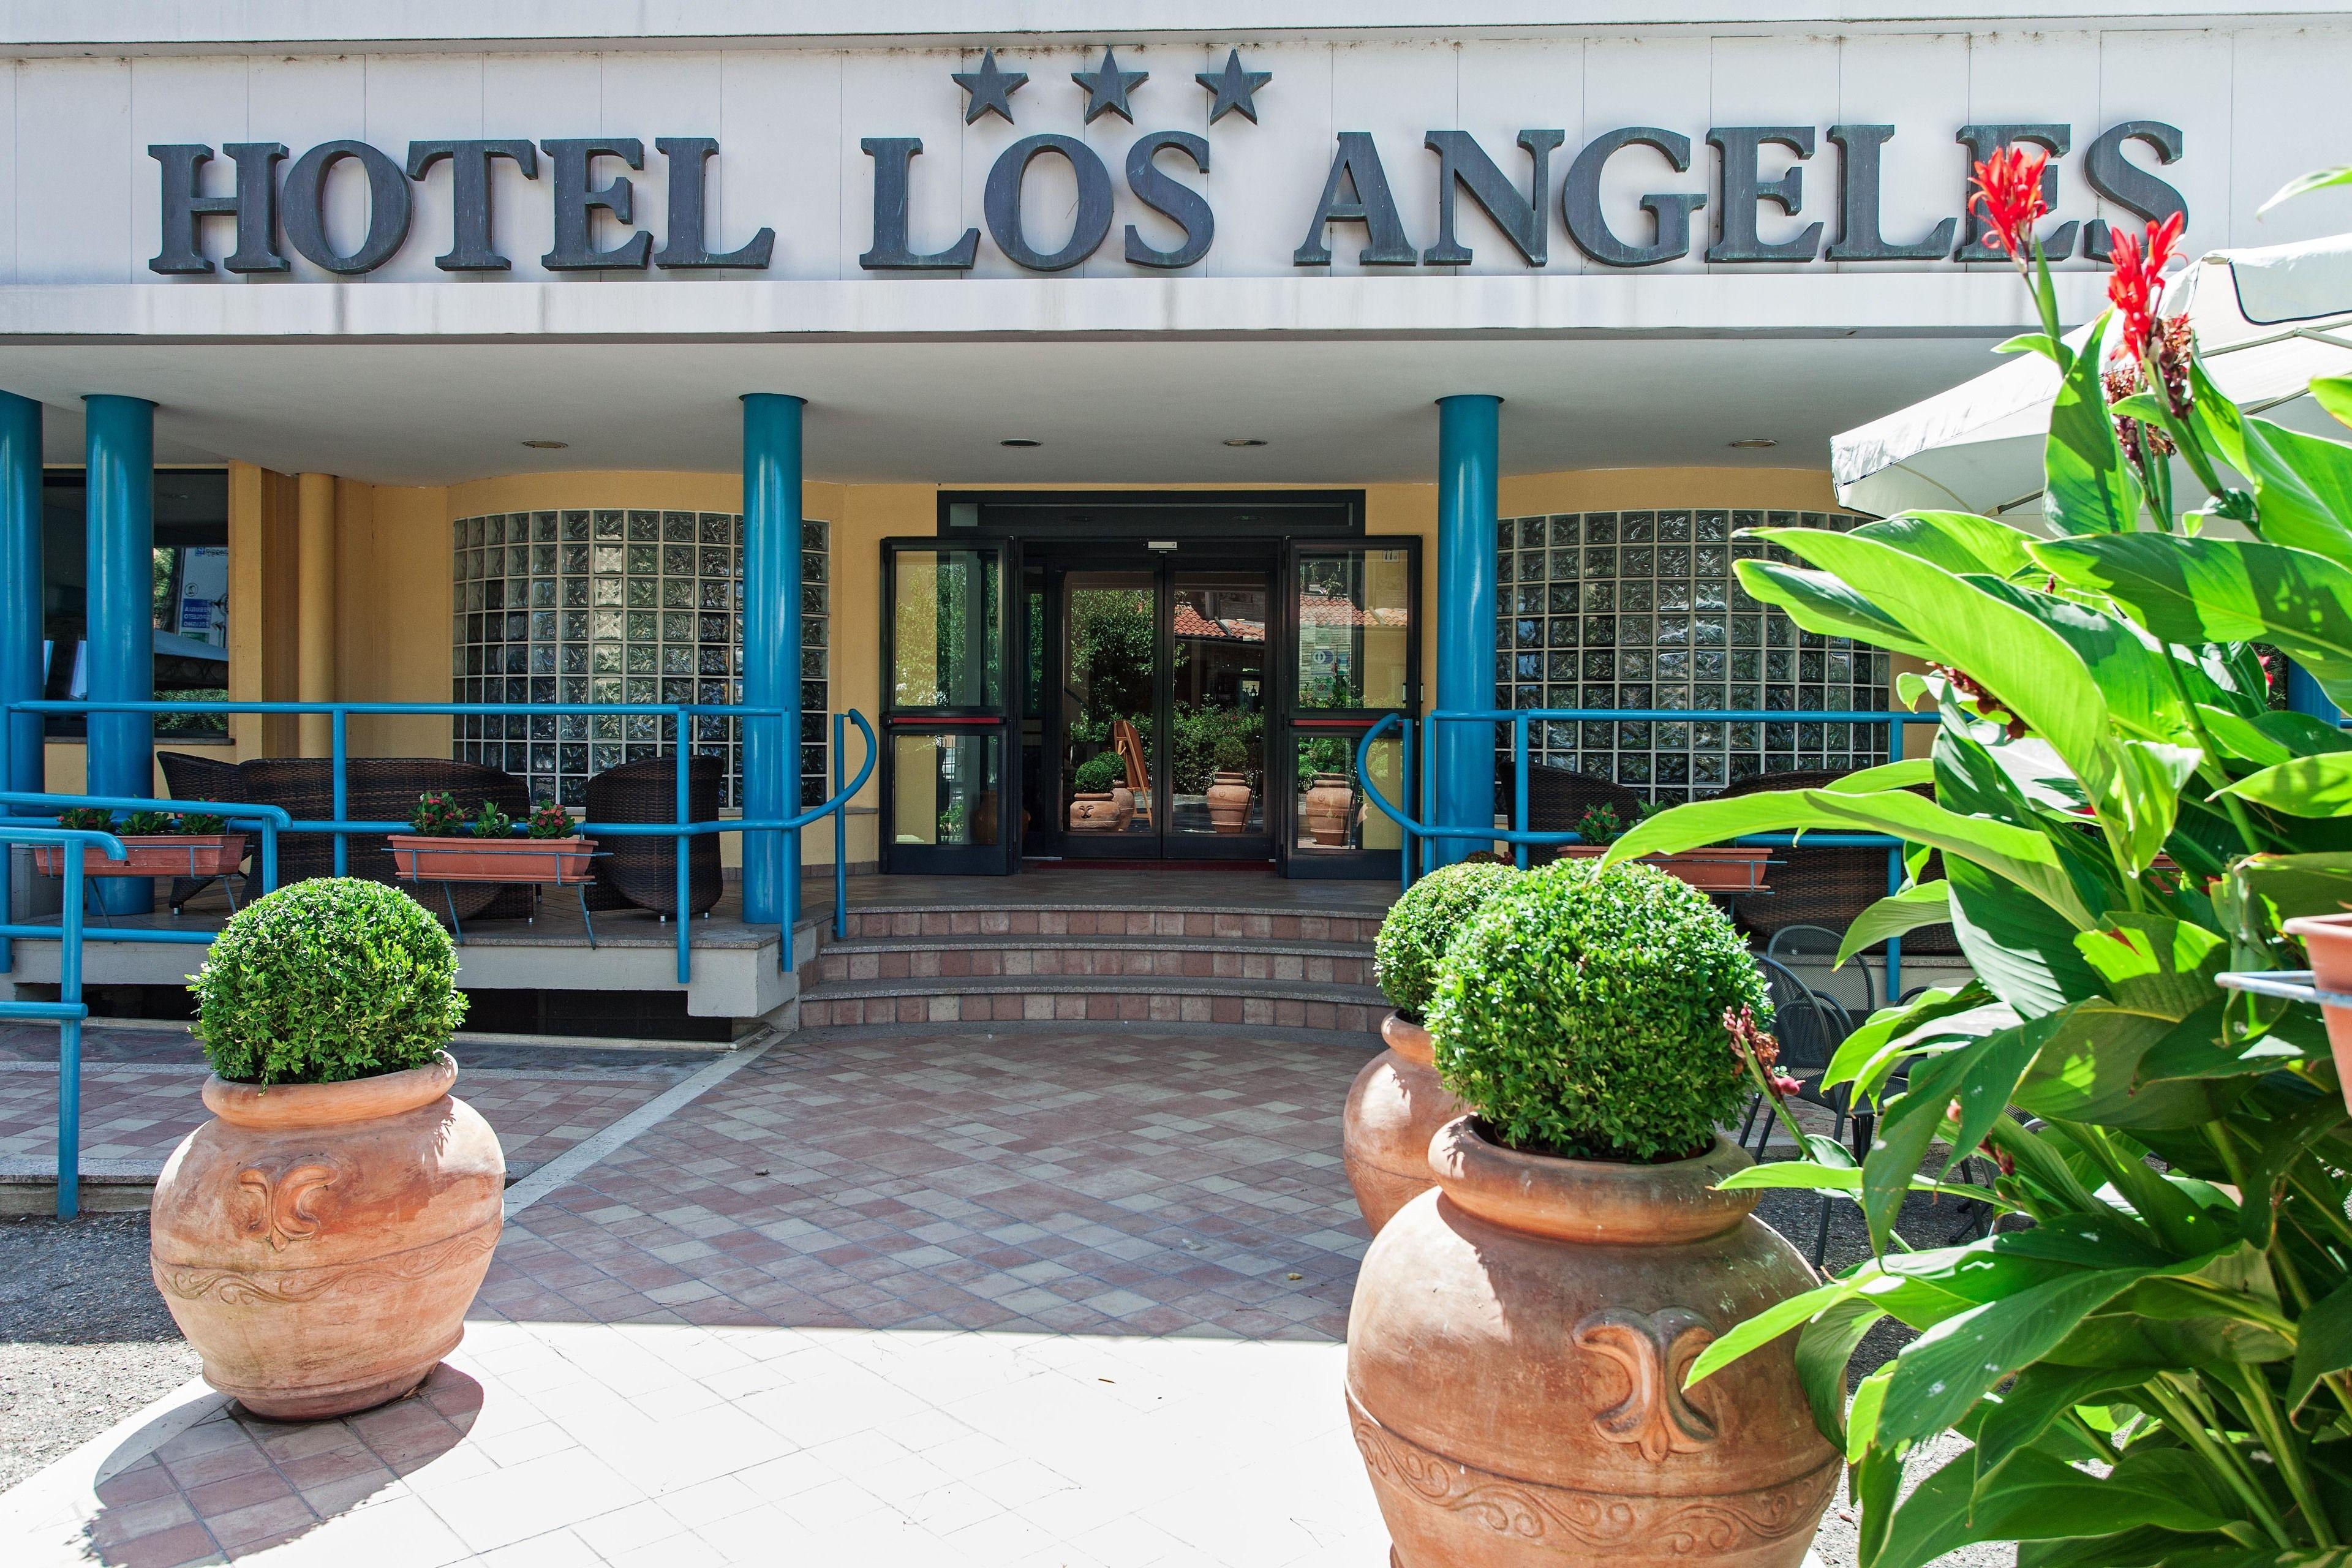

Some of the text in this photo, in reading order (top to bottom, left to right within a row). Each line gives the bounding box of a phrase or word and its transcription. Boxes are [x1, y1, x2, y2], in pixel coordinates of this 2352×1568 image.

[148, 121, 2188, 275] HOTEL LOS ANGELES
